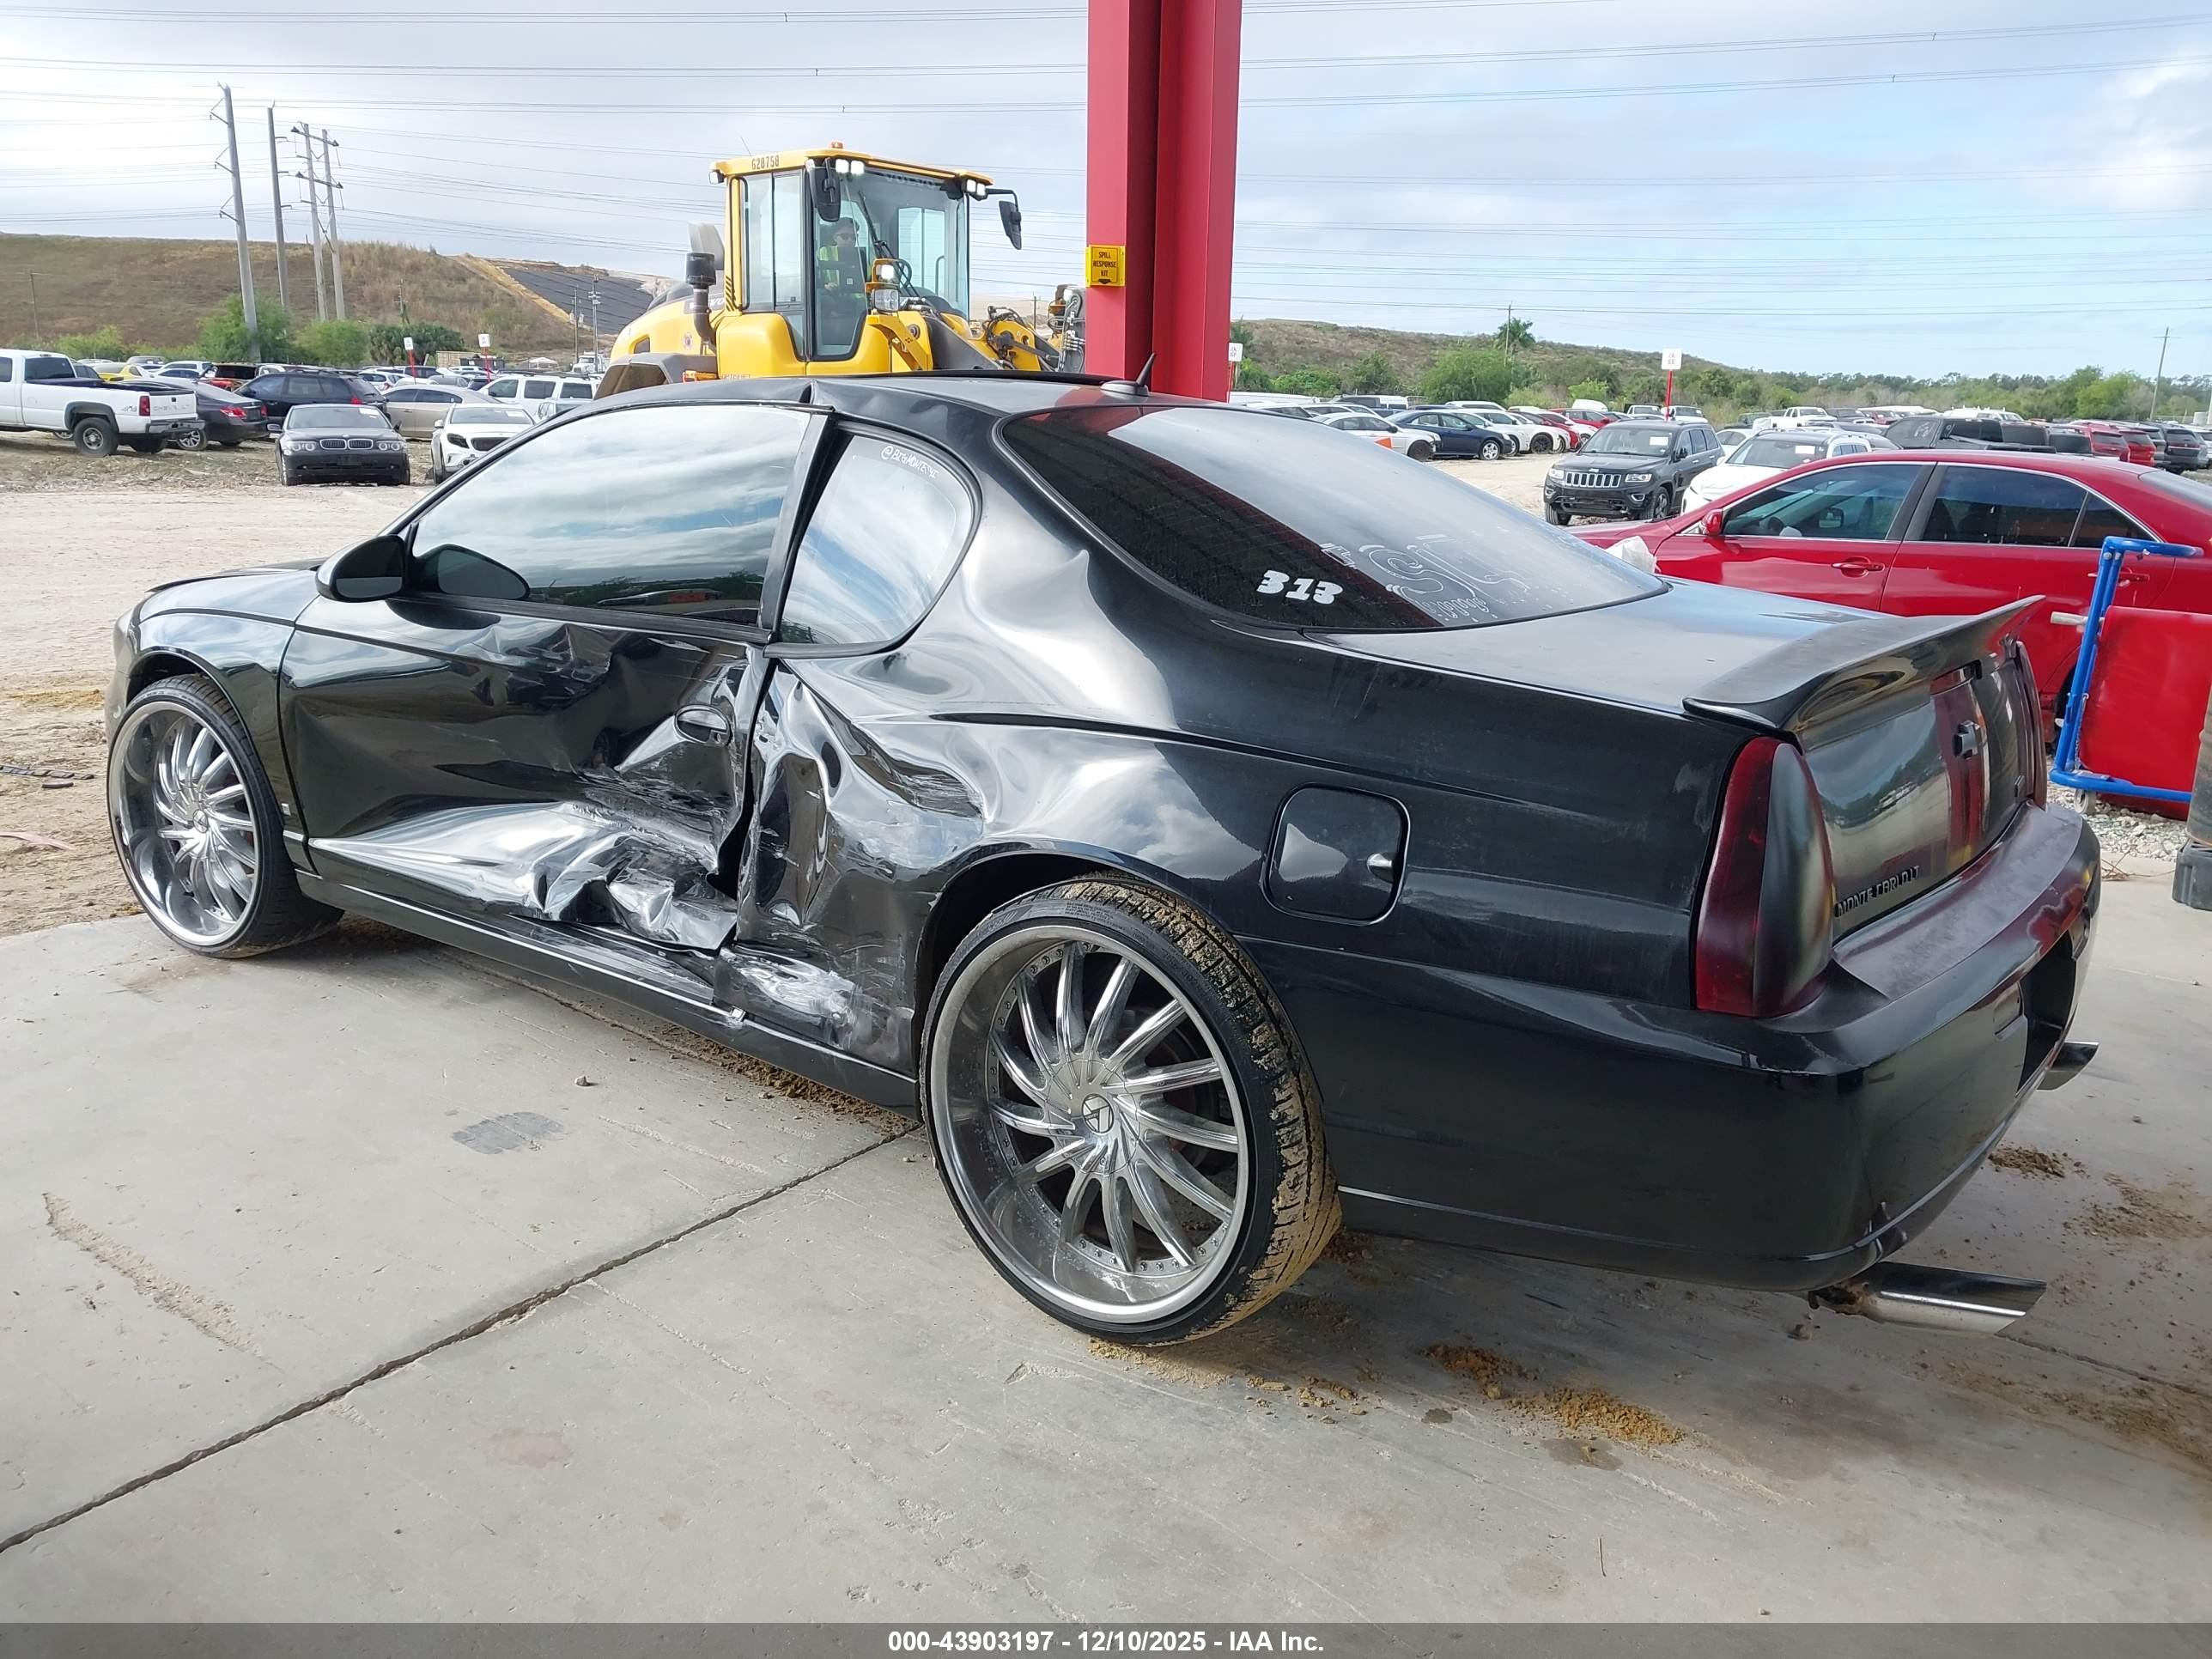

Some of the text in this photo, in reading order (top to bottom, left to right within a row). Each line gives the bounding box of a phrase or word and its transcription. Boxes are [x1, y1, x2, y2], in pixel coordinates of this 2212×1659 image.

[1256, 569, 1344, 605] 313
[1835, 888, 1877, 917] MONTE
[1876, 870, 1910, 898] CARLO
